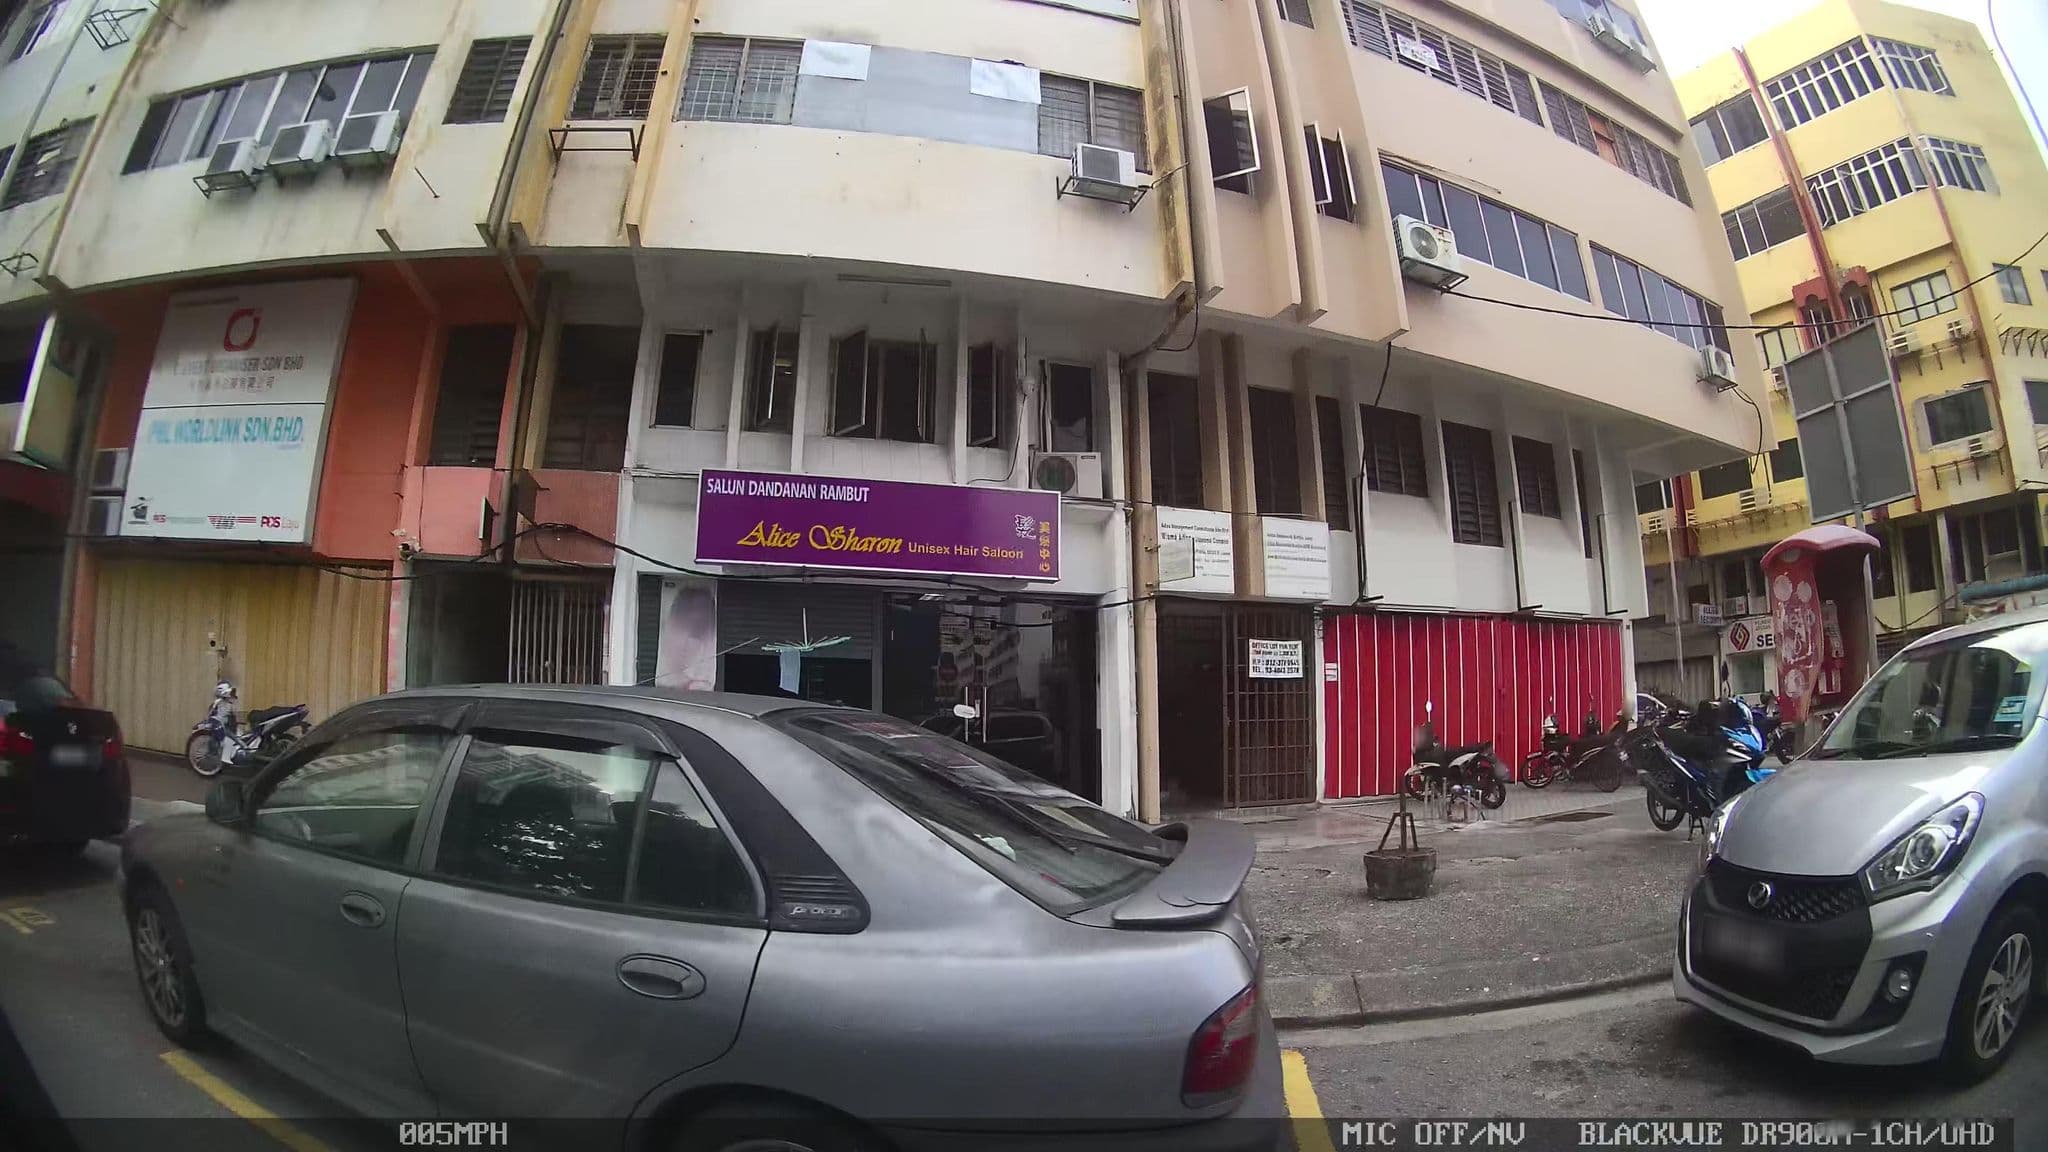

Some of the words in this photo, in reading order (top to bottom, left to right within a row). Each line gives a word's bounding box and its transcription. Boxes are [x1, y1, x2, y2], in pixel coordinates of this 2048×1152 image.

[262, 356, 282, 371] SDN
[284, 353, 304, 370] BHD
[707, 478, 746, 495] SALUN
[749, 480, 817, 499] DANDANAN
[820, 484, 870, 503] RAMBUT
[260, 516, 281, 529] POS
[736, 520, 801, 548] Alice
[809, 524, 903, 554] Sharon
[908, 542, 950, 555] Unisex
[954, 545, 979, 557] Hair
[982, 546, 1024, 560] Saloon
[1757, 634, 1776, 648] SE
